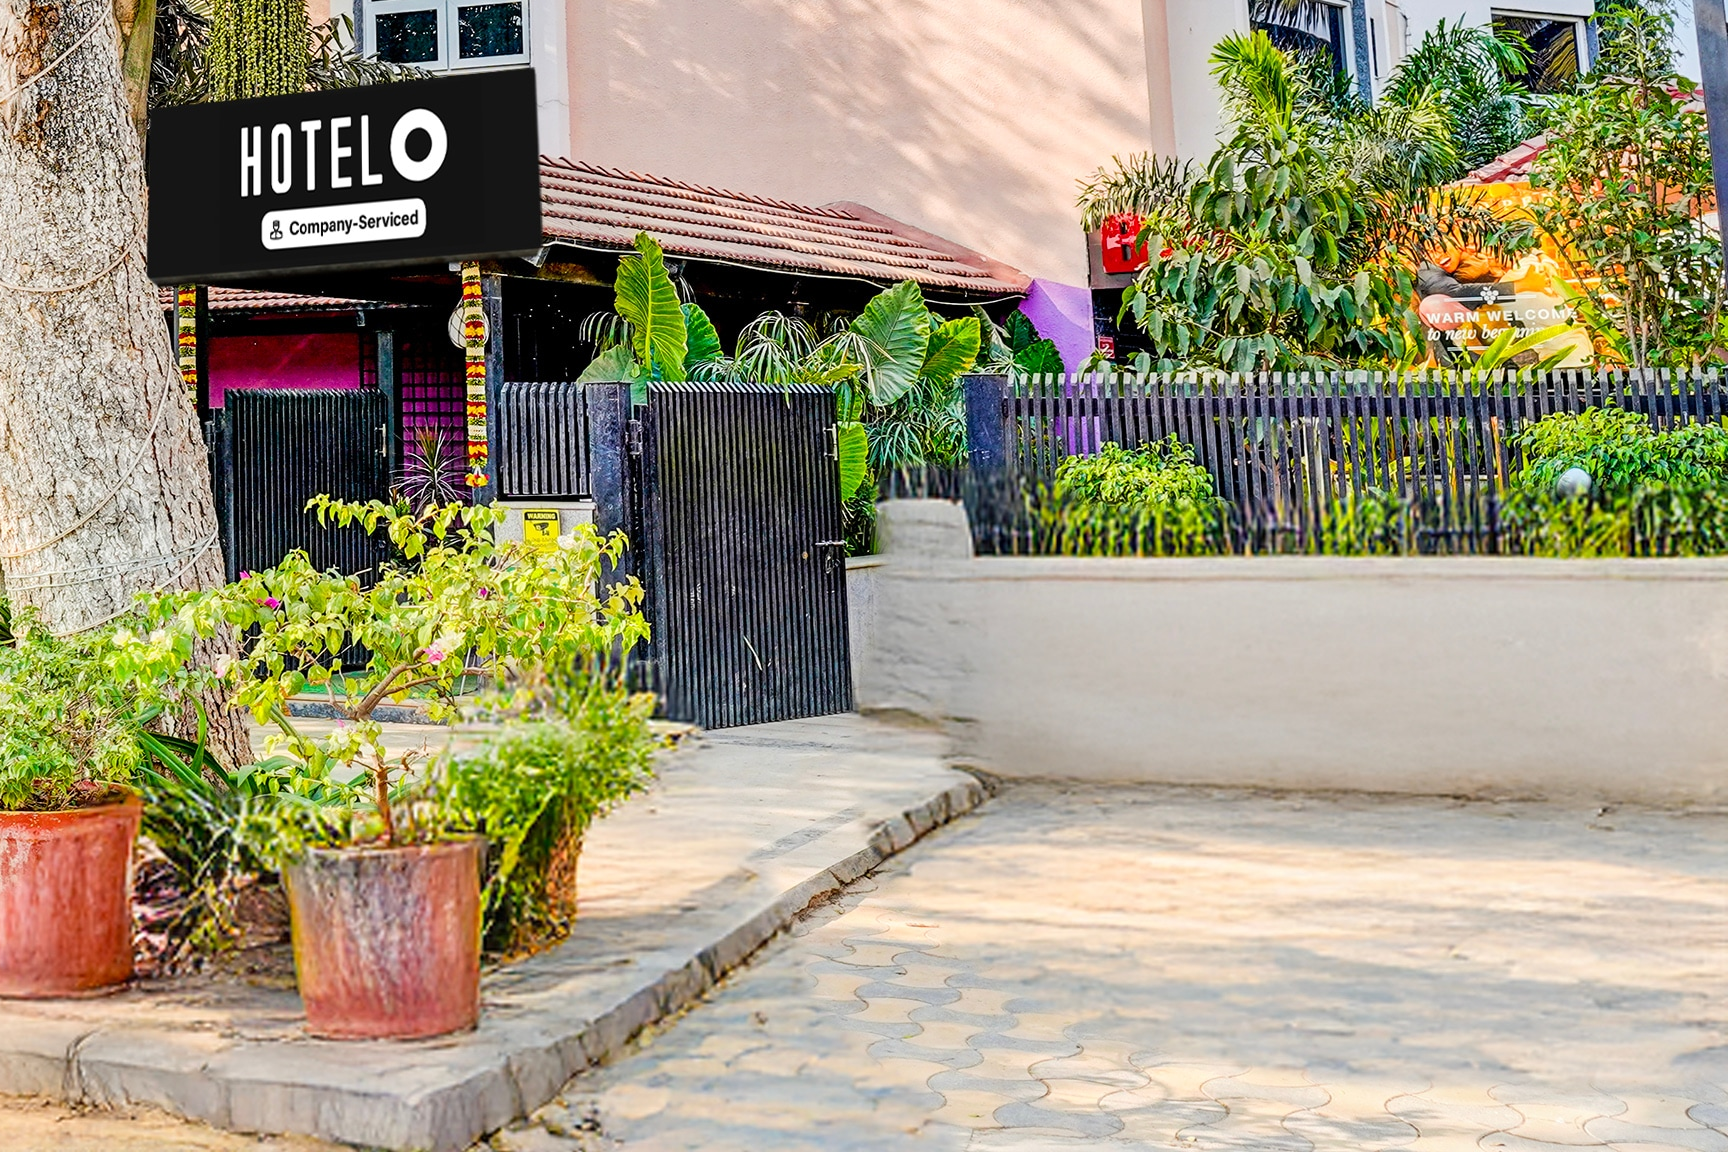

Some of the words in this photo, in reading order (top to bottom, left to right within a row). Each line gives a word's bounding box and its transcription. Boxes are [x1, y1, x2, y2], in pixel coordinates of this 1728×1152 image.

[289, 209, 419, 237] Company-Serviced
[1426, 311, 1480, 325] WARM
[1427, 327, 1441, 342] to
[1445, 328, 1477, 341] new
